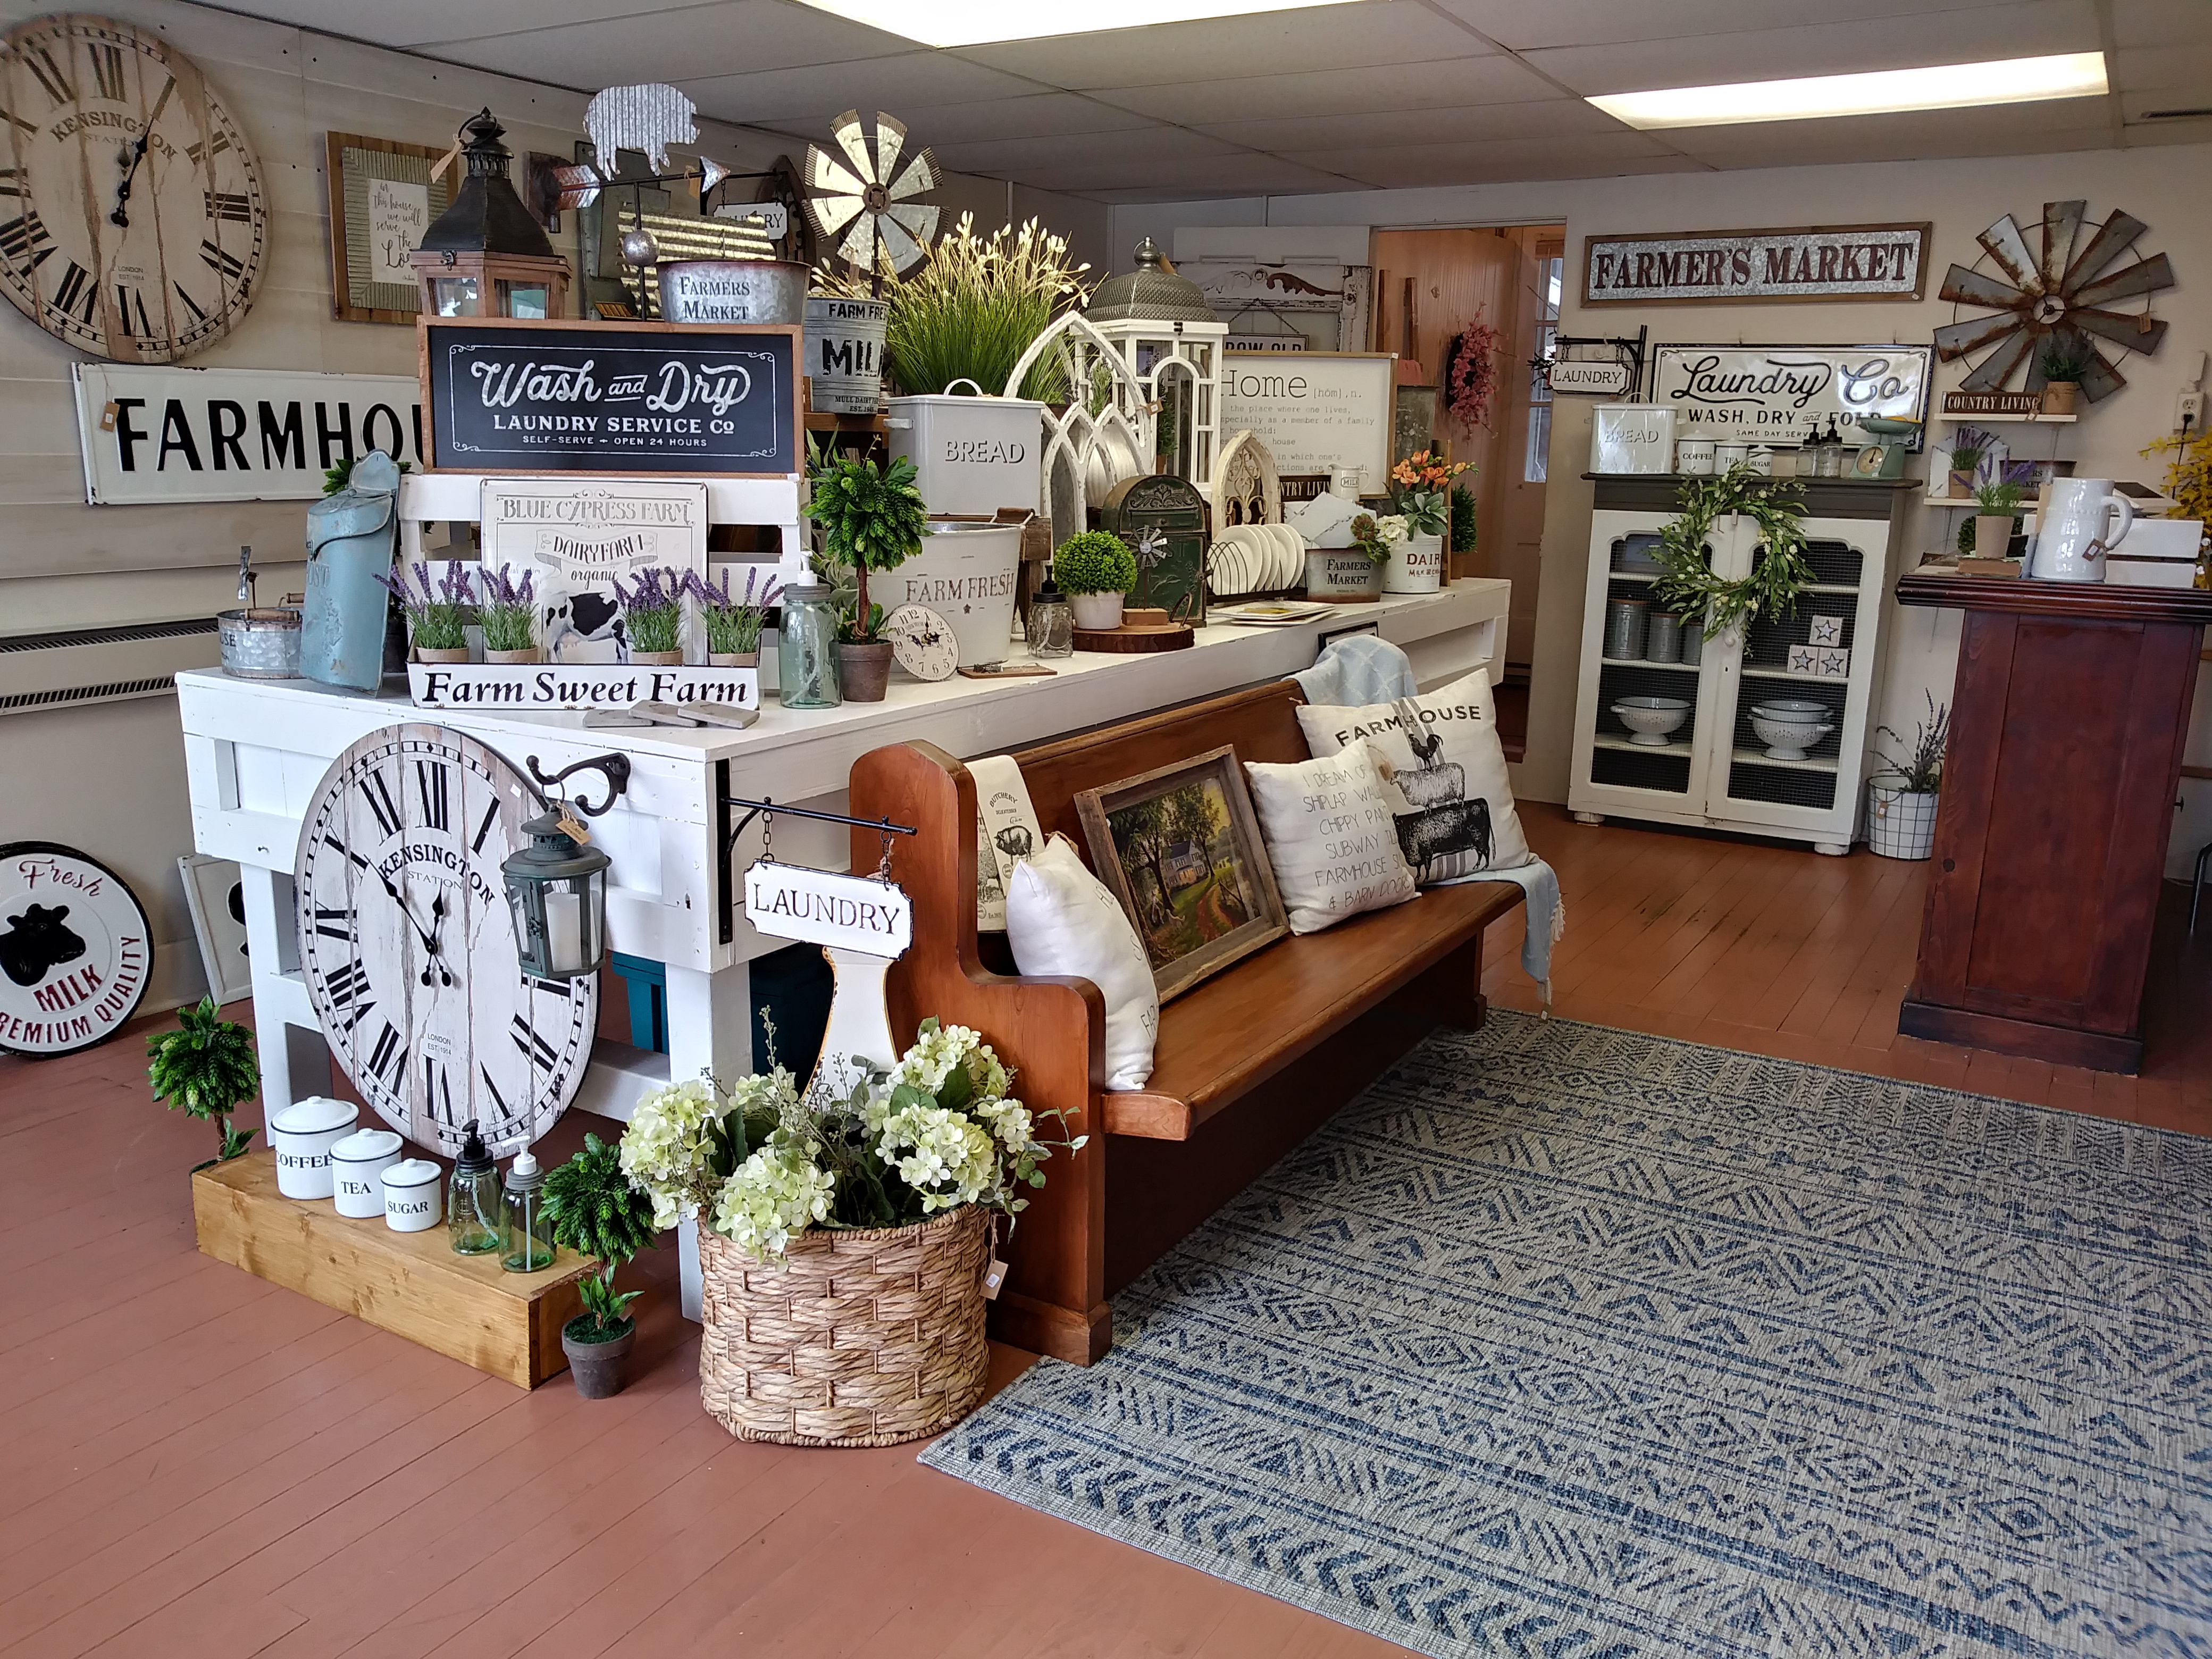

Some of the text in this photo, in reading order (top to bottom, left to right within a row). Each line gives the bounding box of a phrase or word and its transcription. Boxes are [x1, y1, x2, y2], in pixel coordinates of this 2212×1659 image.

[50, 111, 178, 161] KENSINGTON
[83, 133, 139, 148] STATIO
[373, 192, 387, 209] this
[388, 207, 422, 227] we will
[376, 221, 400, 232] serve
[395, 230, 413, 251] the
[1594, 242, 1914, 290] FARMER'S MARKET
[680, 276, 751, 297] FARMERS
[683, 300, 750, 320] MARKET
[828, 303, 887, 321] FARM FRES
[822, 338, 884, 378] MIL
[1220, 370, 1307, 398] Home
[1553, 369, 1622, 384] LAUNDRY
[1670, 355, 1909, 408] Laundry Co
[471, 359, 751, 417] Wash and Dry
[1249, 406, 1273, 415] place
[1947, 396, 1997, 409] COUNTRY
[493, 414, 599, 432] LAUNDRY
[607, 417, 702, 434] SERVICE
[1688, 408, 1749, 424] WASH,
[1757, 410, 1796, 425] DRY
[1803, 412, 1822, 422] and
[113, 397, 423, 472] FARMHO
[523, 435, 708, 447] SELF-SERVE OPEN 24 HOURS
[1605, 429, 1659, 443] BREAD
[944, 439, 1026, 464] BREAD
[1280, 481, 1304, 496] NTRY
[504, 499, 691, 524] BLUE CYPRESS FARM
[1327, 559, 1371, 571] FARMERS
[1406, 553, 1441, 565] DAIR
[571, 566, 618, 591] organic
[905, 572, 1015, 602] FARM FRESH
[1327, 573, 1368, 585] MARKET
[899, 614, 909, 624] 11
[907, 609, 919, 619] 12
[894, 626, 905, 636] 10
[936, 620, 944, 631] 2
[895, 640, 903, 650] 9
[945, 632, 952, 643] 3
[904, 652, 914, 664] 8
[948, 647, 953, 657] 4
[918, 661, 924, 672] 7
[932, 663, 939, 674] 6
[942, 658, 950, 668] 5
[422, 672, 748, 703] Farm Sweet Farm
[1335, 705, 1482, 747] FARMHOUSE
[1313, 769, 1353, 787] DREAM
[1354, 764, 1366, 780] OF
[989, 792, 1018, 808] BUTCHERY
[1325, 832, 1379, 859] SUBWAY
[18, 858, 104, 898] Fresh
[378, 843, 496, 905] KENSINGTON
[407, 870, 463, 891] STATION
[1314, 857, 1387, 887] FARMHOUSE
[1344, 885, 1376, 908] BARN
[753, 883, 900, 936] LAUNDRY
[95, 936, 141, 1022] QUALITY
[33, 963, 103, 1013] MILK
[427, 1033, 451, 1046] LONDON
[440, 1046, 451, 1055] 1914
[275, 1154, 334, 1169] COFFEE
[340, 1181, 372, 1195] TEA
[388, 1200, 429, 1214] SUGAR
